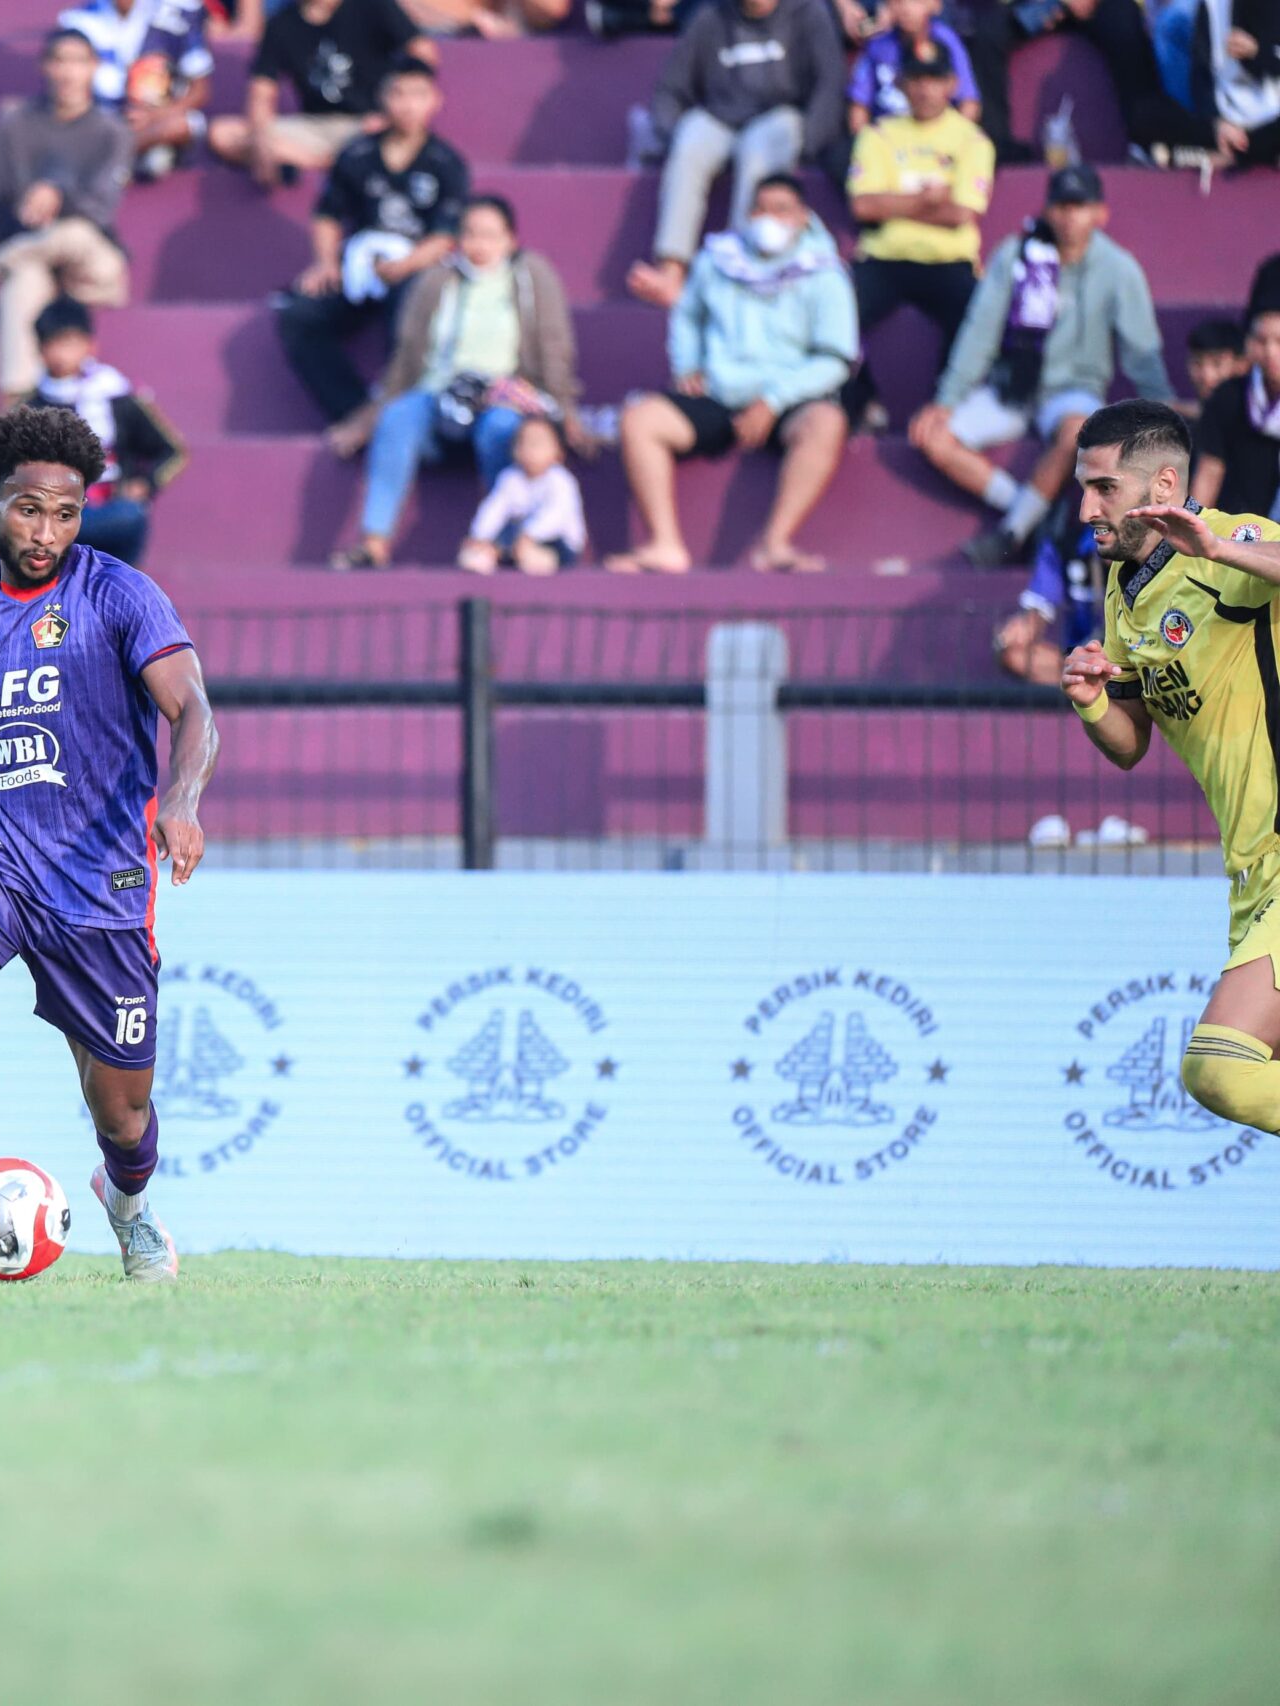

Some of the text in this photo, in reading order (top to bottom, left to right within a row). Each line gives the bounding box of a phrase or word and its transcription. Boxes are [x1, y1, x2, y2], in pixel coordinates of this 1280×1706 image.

[0, 768, 41, 788] Foods
[115, 1007, 147, 1045] 16
[124, 996, 146, 1005] DRX
[417, 967, 608, 1034] PERSIK KEDIRI
[744, 968, 939, 1037] PERSIK KEDIRI
[1076, 972, 1176, 1041] PERSIK
[405, 1101, 608, 1181] OFFICIAL STORE
[732, 1104, 938, 1184] OFFICIAL STORE
[1065, 1111, 1261, 1189] OFFICIAL STOR
